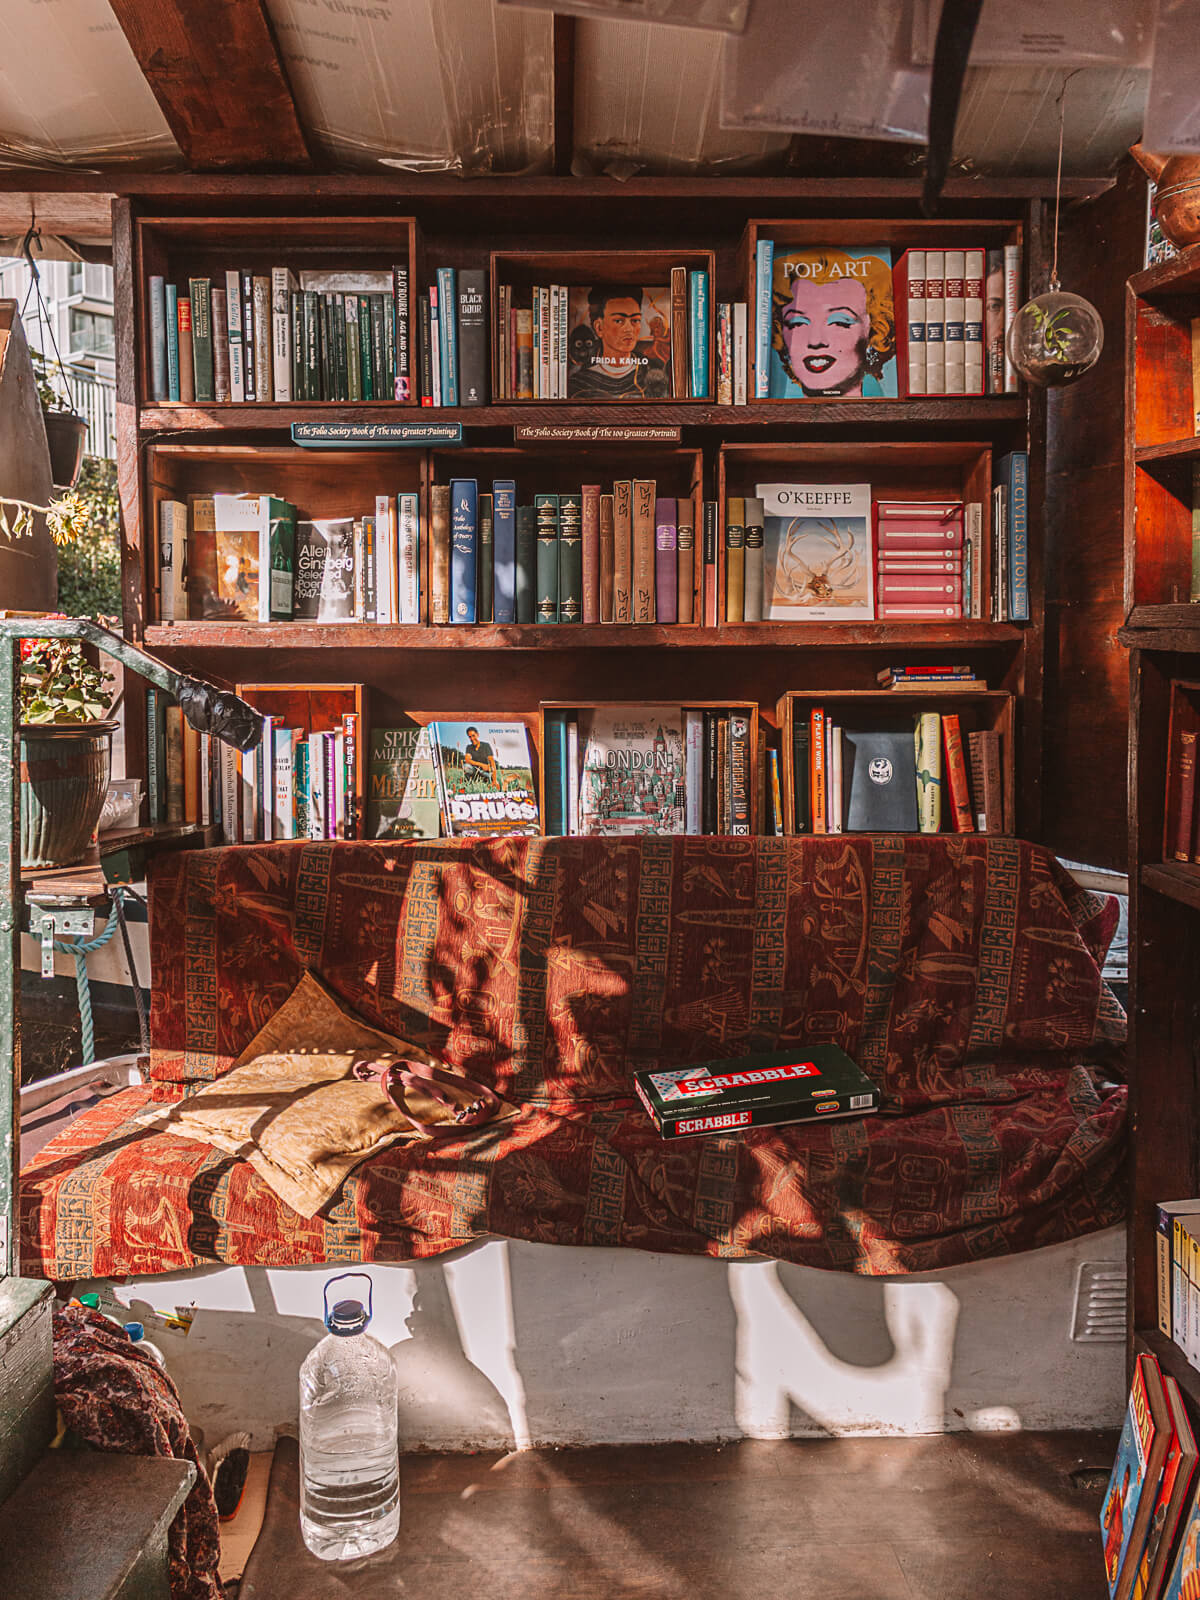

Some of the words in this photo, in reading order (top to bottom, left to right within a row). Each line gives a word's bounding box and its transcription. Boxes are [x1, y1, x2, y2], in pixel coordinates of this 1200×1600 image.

[783, 261, 823, 278] POP
[828, 260, 872, 277] ART
[460, 294, 483, 303] BLACK
[461, 304, 482, 314] DOOR
[399, 320, 407, 334] AGE
[400, 352, 408, 372] GUILE
[590, 356, 617, 365] FRIDA
[619, 357, 649, 365] KAHLO
[297, 425, 311, 436] The
[311, 425, 328, 437] Folio
[329, 426, 351, 438] Society
[351, 425, 369, 436] Book
[369, 425, 377, 438] of
[377, 425, 390, 436] The
[390, 428, 401, 436] 100
[402, 426, 427, 438] Greatest
[427, 426, 458, 439] Paintings
[520, 427, 534, 437] The
[534, 427, 550, 437] Folio
[551, 428, 574, 439] Society
[574, 428, 591, 437] Book
[591, 427, 598, 439] of
[598, 427, 612, 437] The
[612, 429, 623, 437] 100
[624, 428, 648, 439] Greatest
[649, 427, 677, 438] Portraits
[404, 498, 412, 513] THE
[777, 491, 852, 505] O'KEEFFE
[404, 514, 412, 532] BOOK
[1014, 488, 1026, 590] CIVILISATION
[299, 545, 332, 558] Allen
[298, 556, 353, 572] Ginsberg
[298, 568, 342, 579] Selected
[814, 723, 822, 739] PLAY
[383, 731, 430, 748] SPIKE
[815, 741, 822, 749] AT
[374, 747, 431, 760] MILLIGAN
[595, 749, 668, 769] LONDON
[226, 760, 235, 794] Whitehall
[391, 760, 420, 779] THE
[732, 741, 745, 799] CONFEDERACY
[372, 774, 437, 799] MURPHY
[481, 791, 503, 800] YOUR
[506, 790, 529, 798] OWN
[450, 801, 537, 820] DRUGS
[686, 1065, 812, 1093] SCRABBLE
[678, 1111, 749, 1134] SCRABBLE
